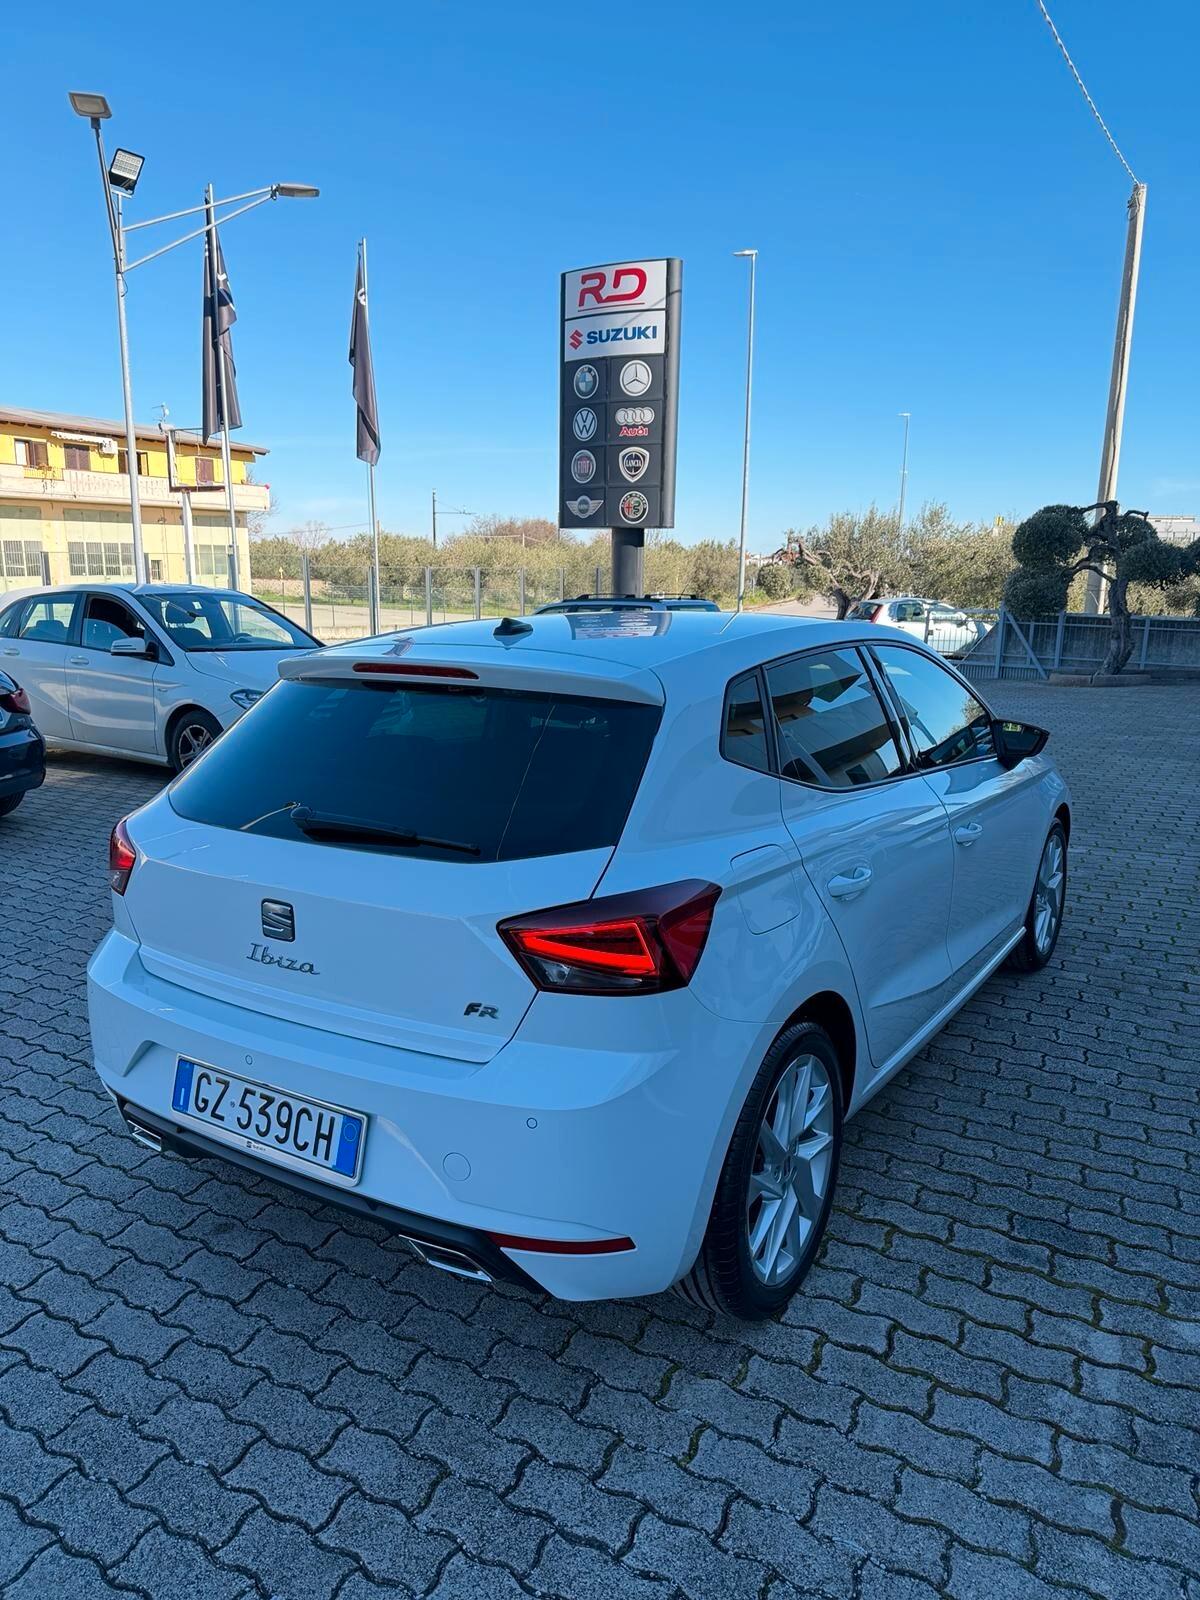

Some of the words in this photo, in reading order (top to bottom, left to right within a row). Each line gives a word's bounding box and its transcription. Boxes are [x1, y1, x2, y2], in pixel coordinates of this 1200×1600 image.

[578, 268, 647, 307] RD
[587, 325, 657, 345] SUZUKI
[619, 426, 649, 437] Audi
[246, 942, 321, 976] Ibiza
[463, 1002, 500, 1020] FR
